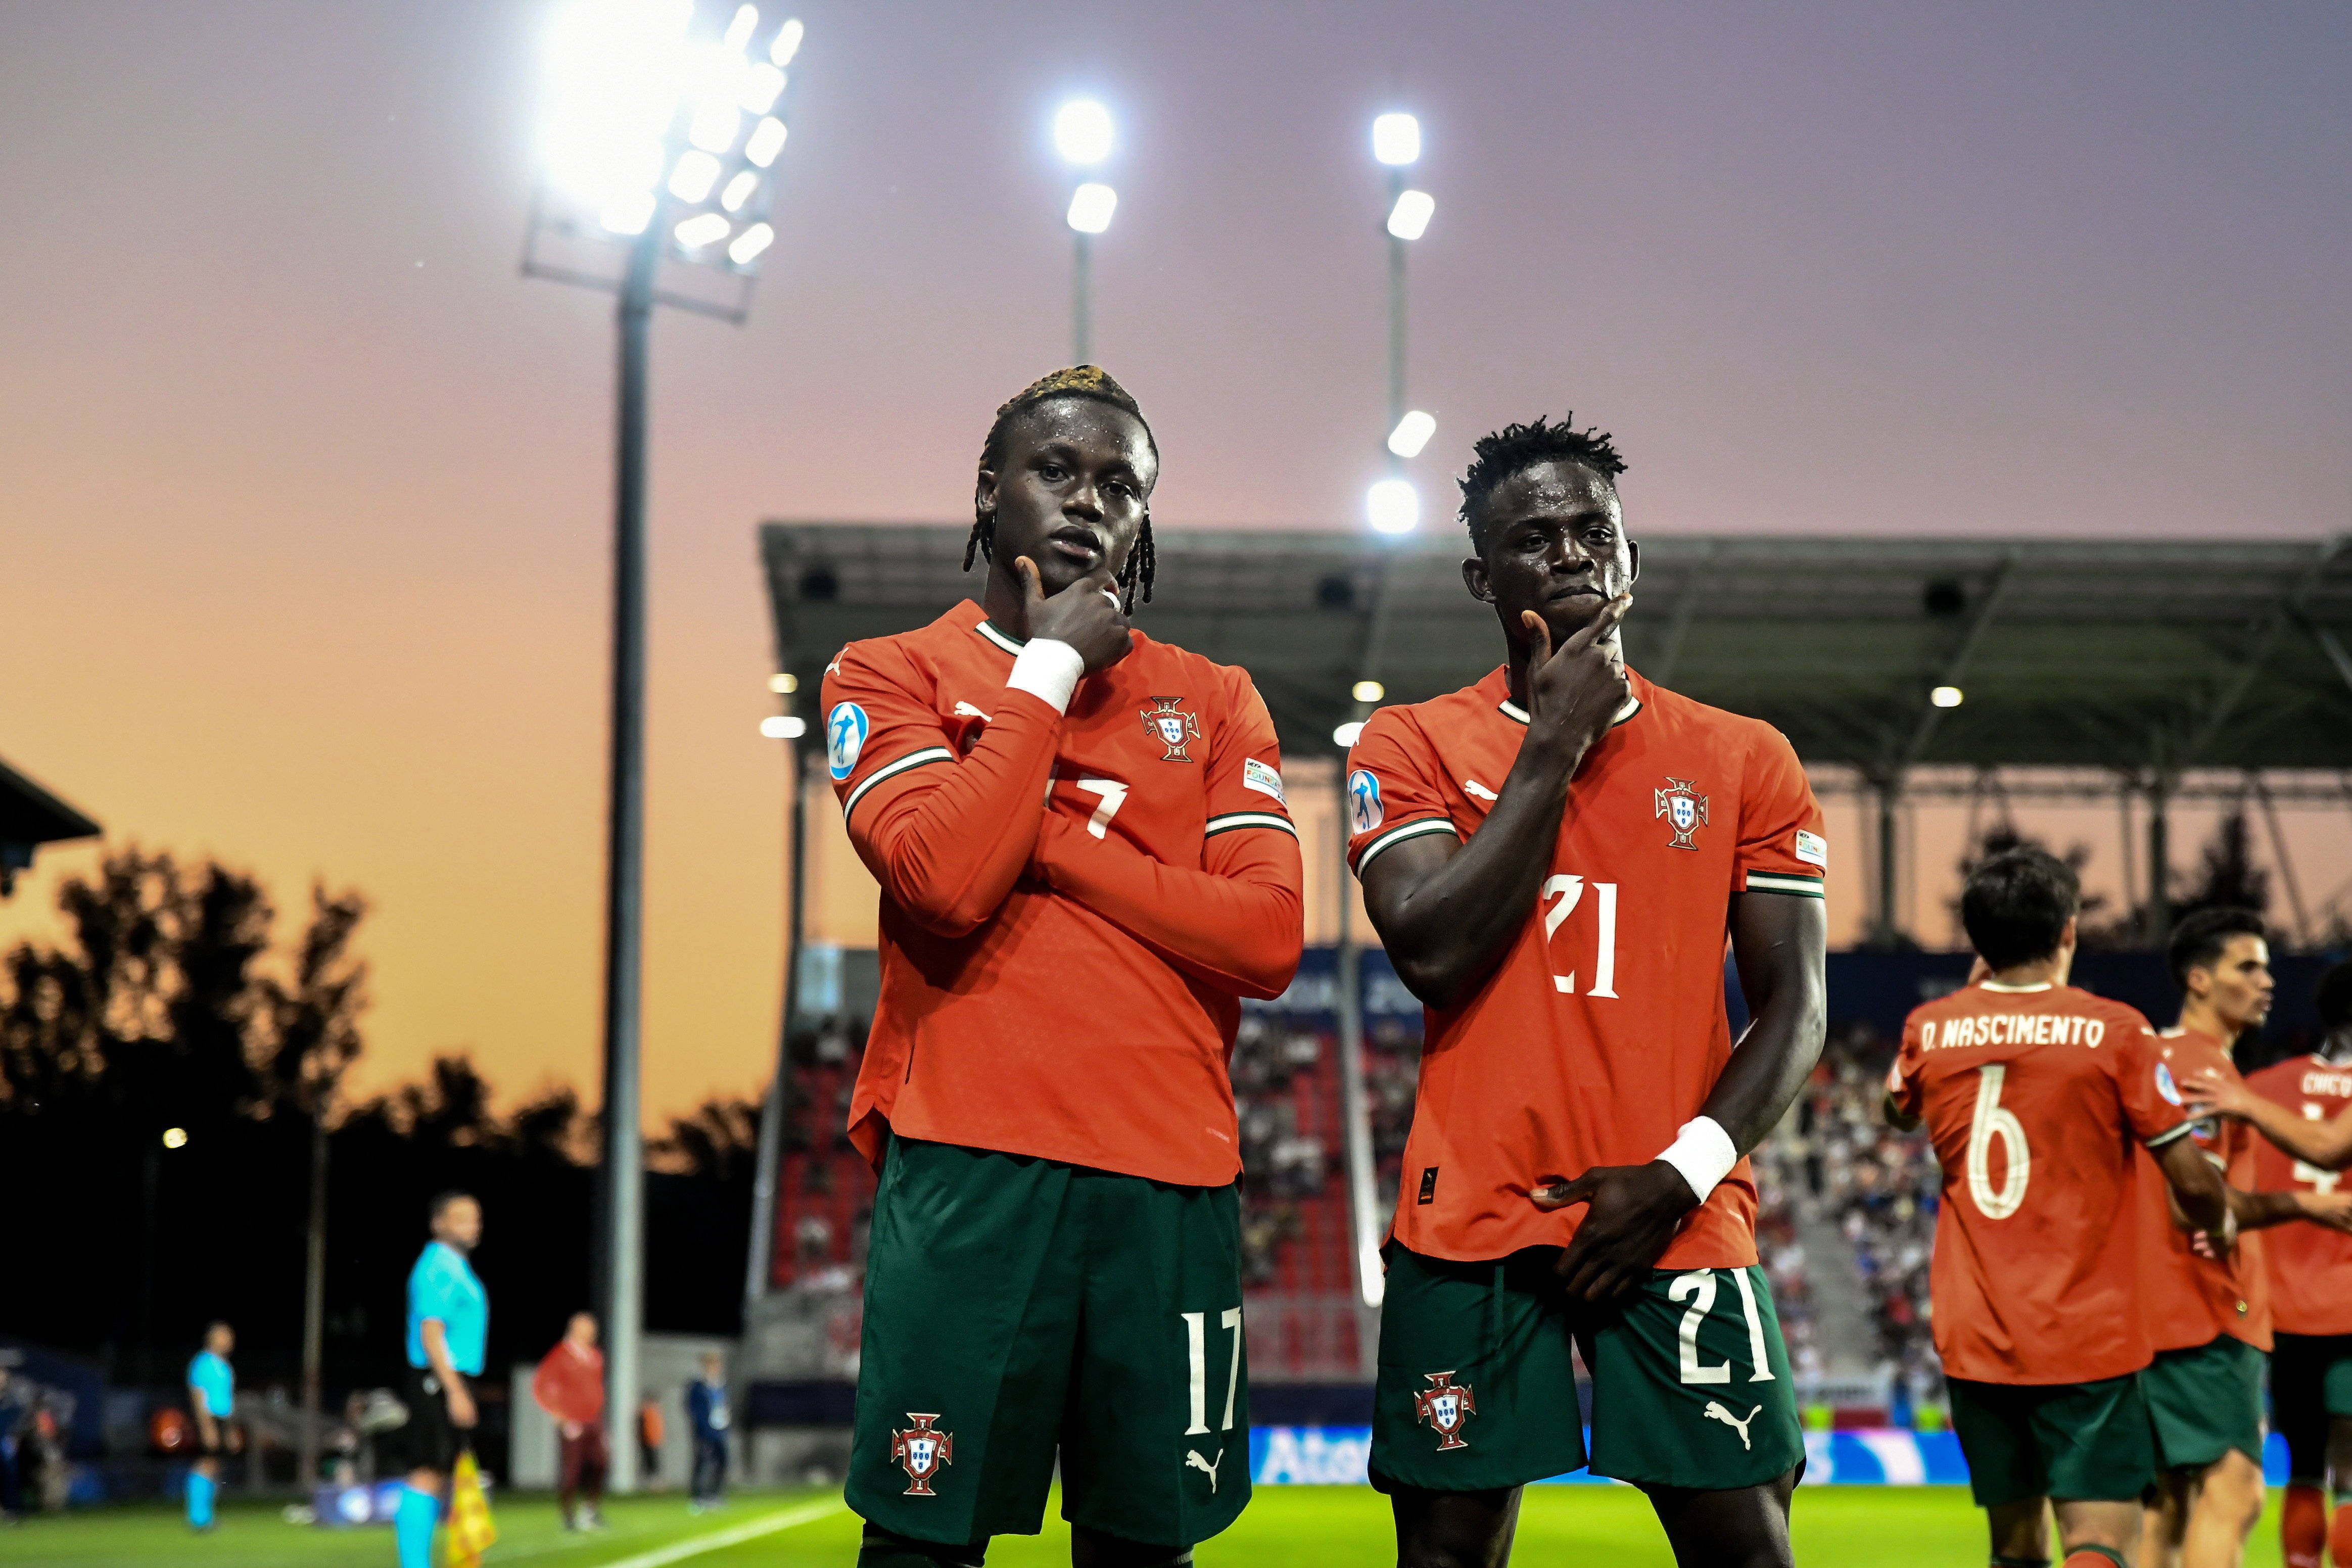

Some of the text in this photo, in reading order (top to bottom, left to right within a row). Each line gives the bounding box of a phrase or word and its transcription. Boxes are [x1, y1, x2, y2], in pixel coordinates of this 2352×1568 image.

[1542, 874, 1620, 999] 21
[1941, 1014, 2105, 1049] NASCIMENTO
[1966, 1063, 2031, 1220] 6
[1181, 1305, 1242, 1436] 17
[1668, 1267, 1776, 1384] 21
